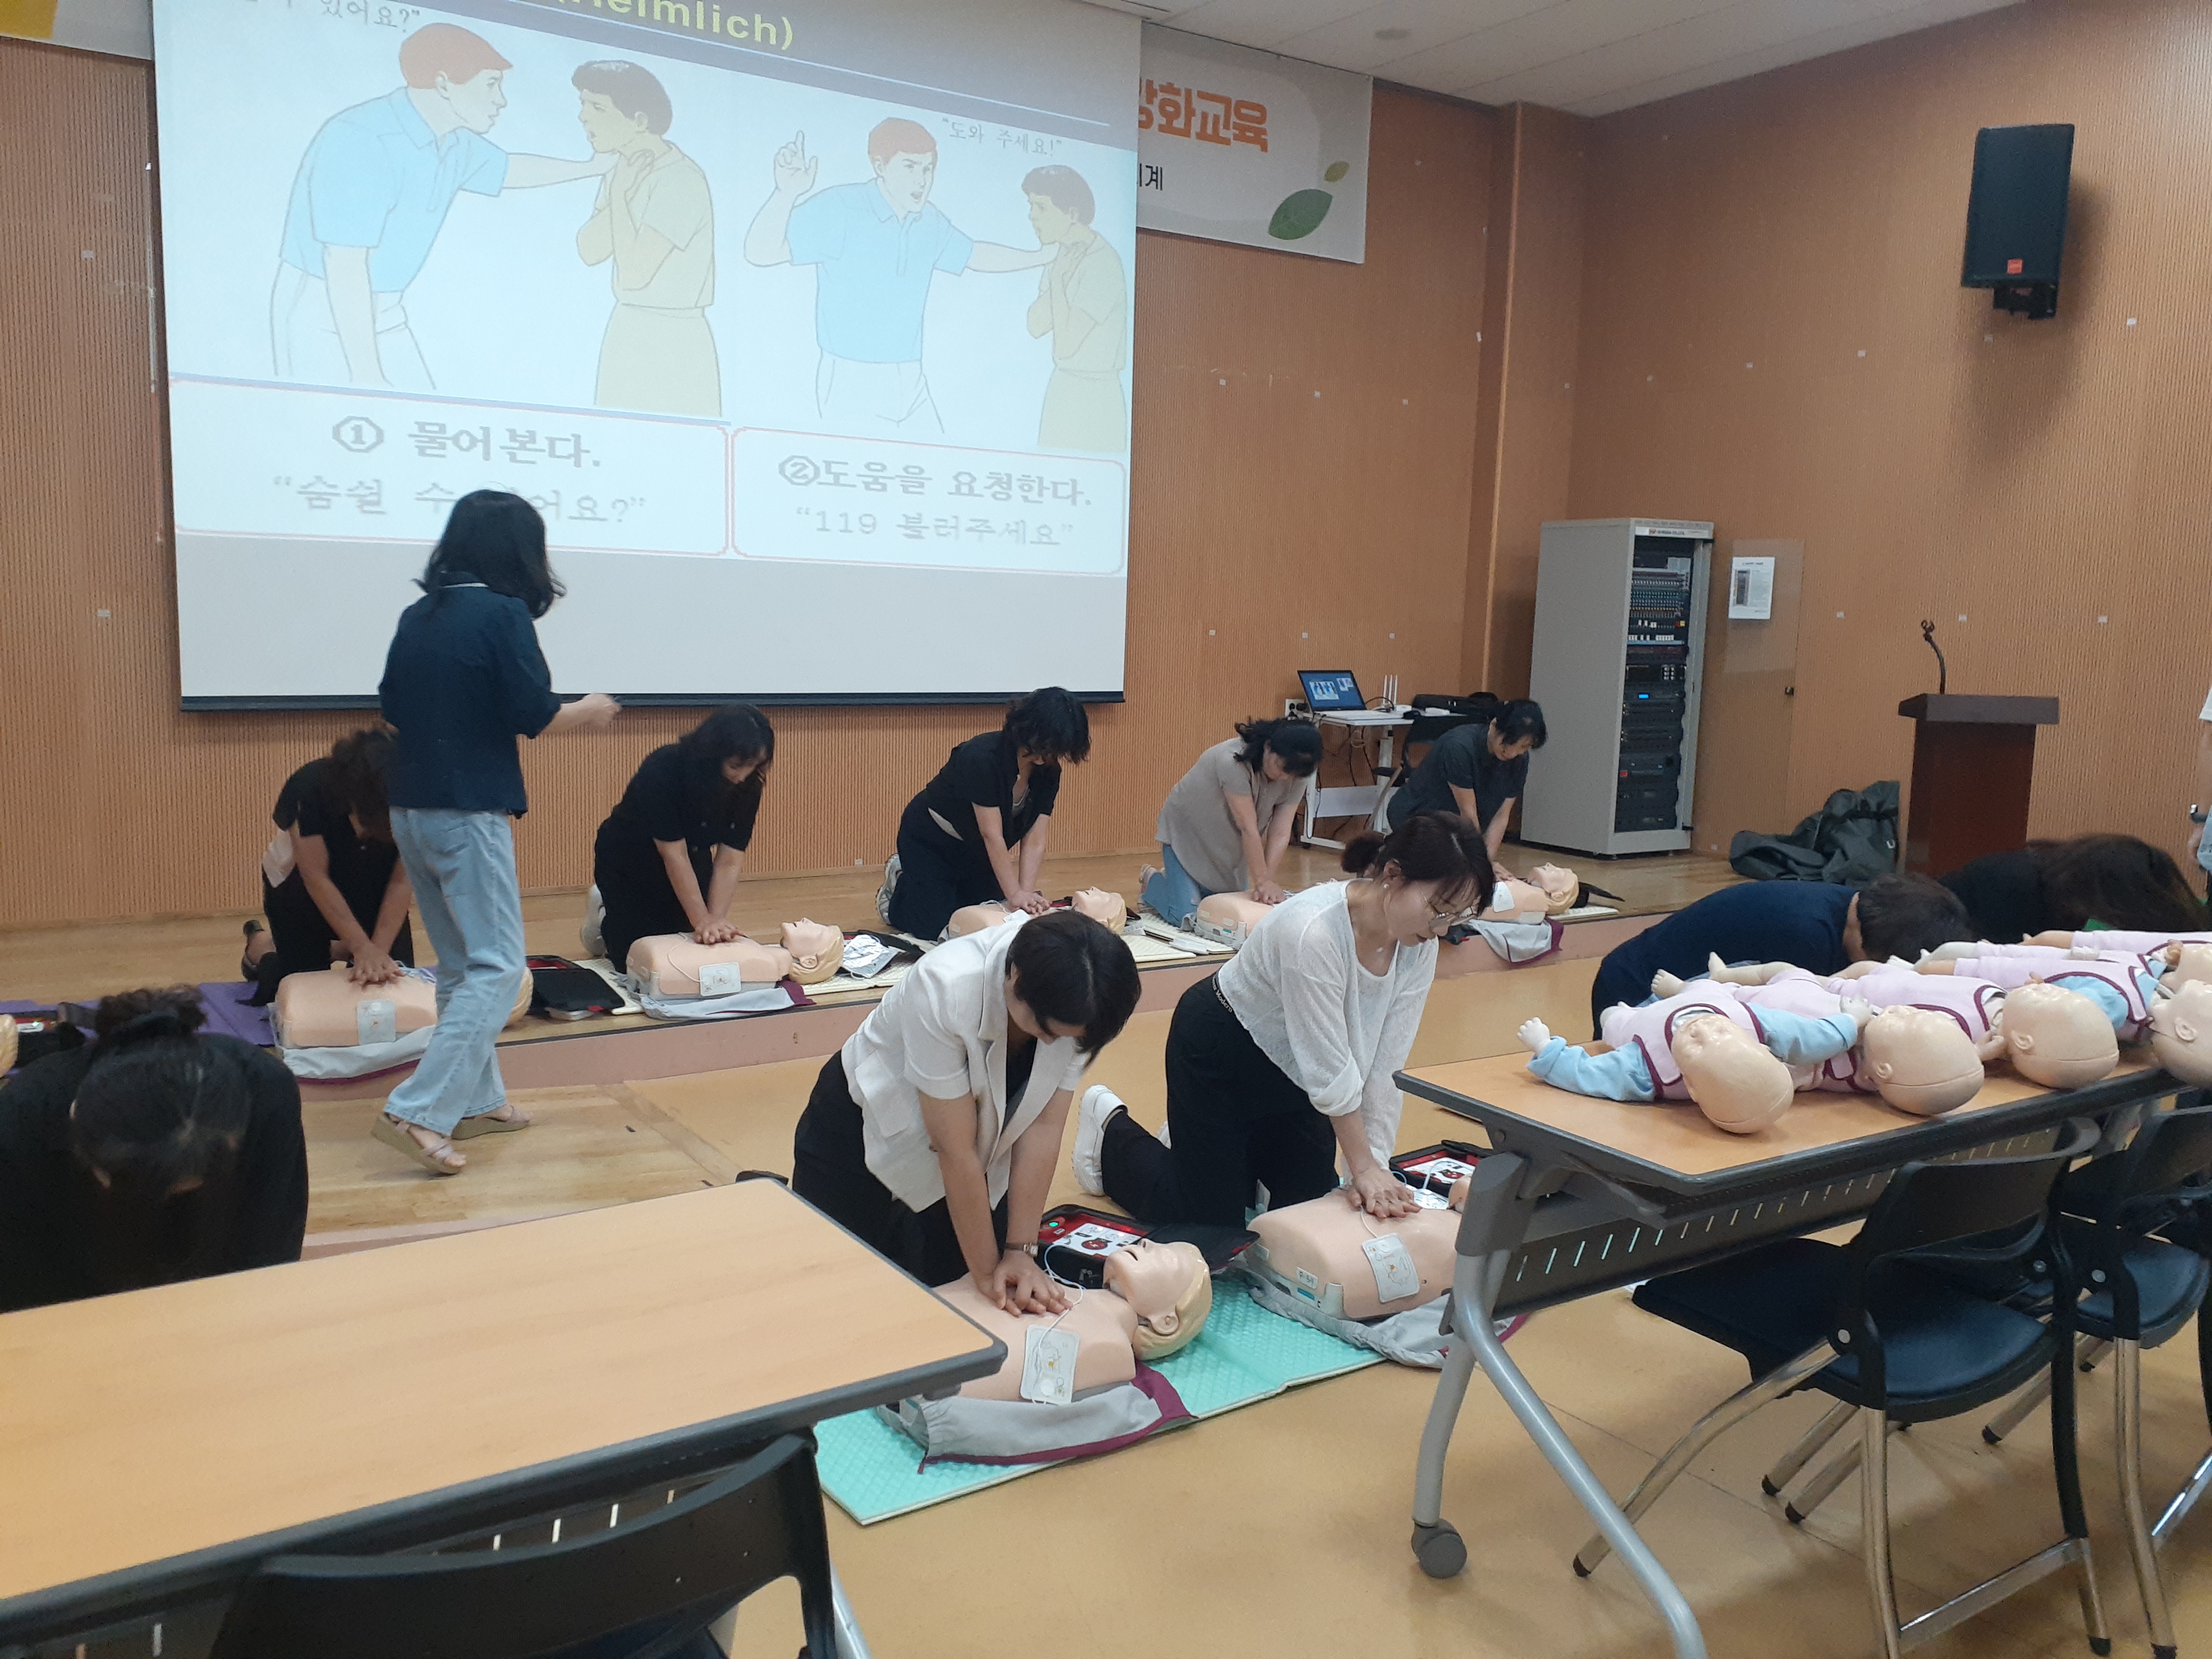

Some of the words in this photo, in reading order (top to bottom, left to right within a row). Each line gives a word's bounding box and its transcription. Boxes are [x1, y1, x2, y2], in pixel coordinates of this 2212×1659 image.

[559, 0, 793, 50] eimlich)
[408, 420, 601, 468] 물어본다.
[509, 487, 646, 523] 어요?”
[947, 469, 1093, 507] 요청한다.
